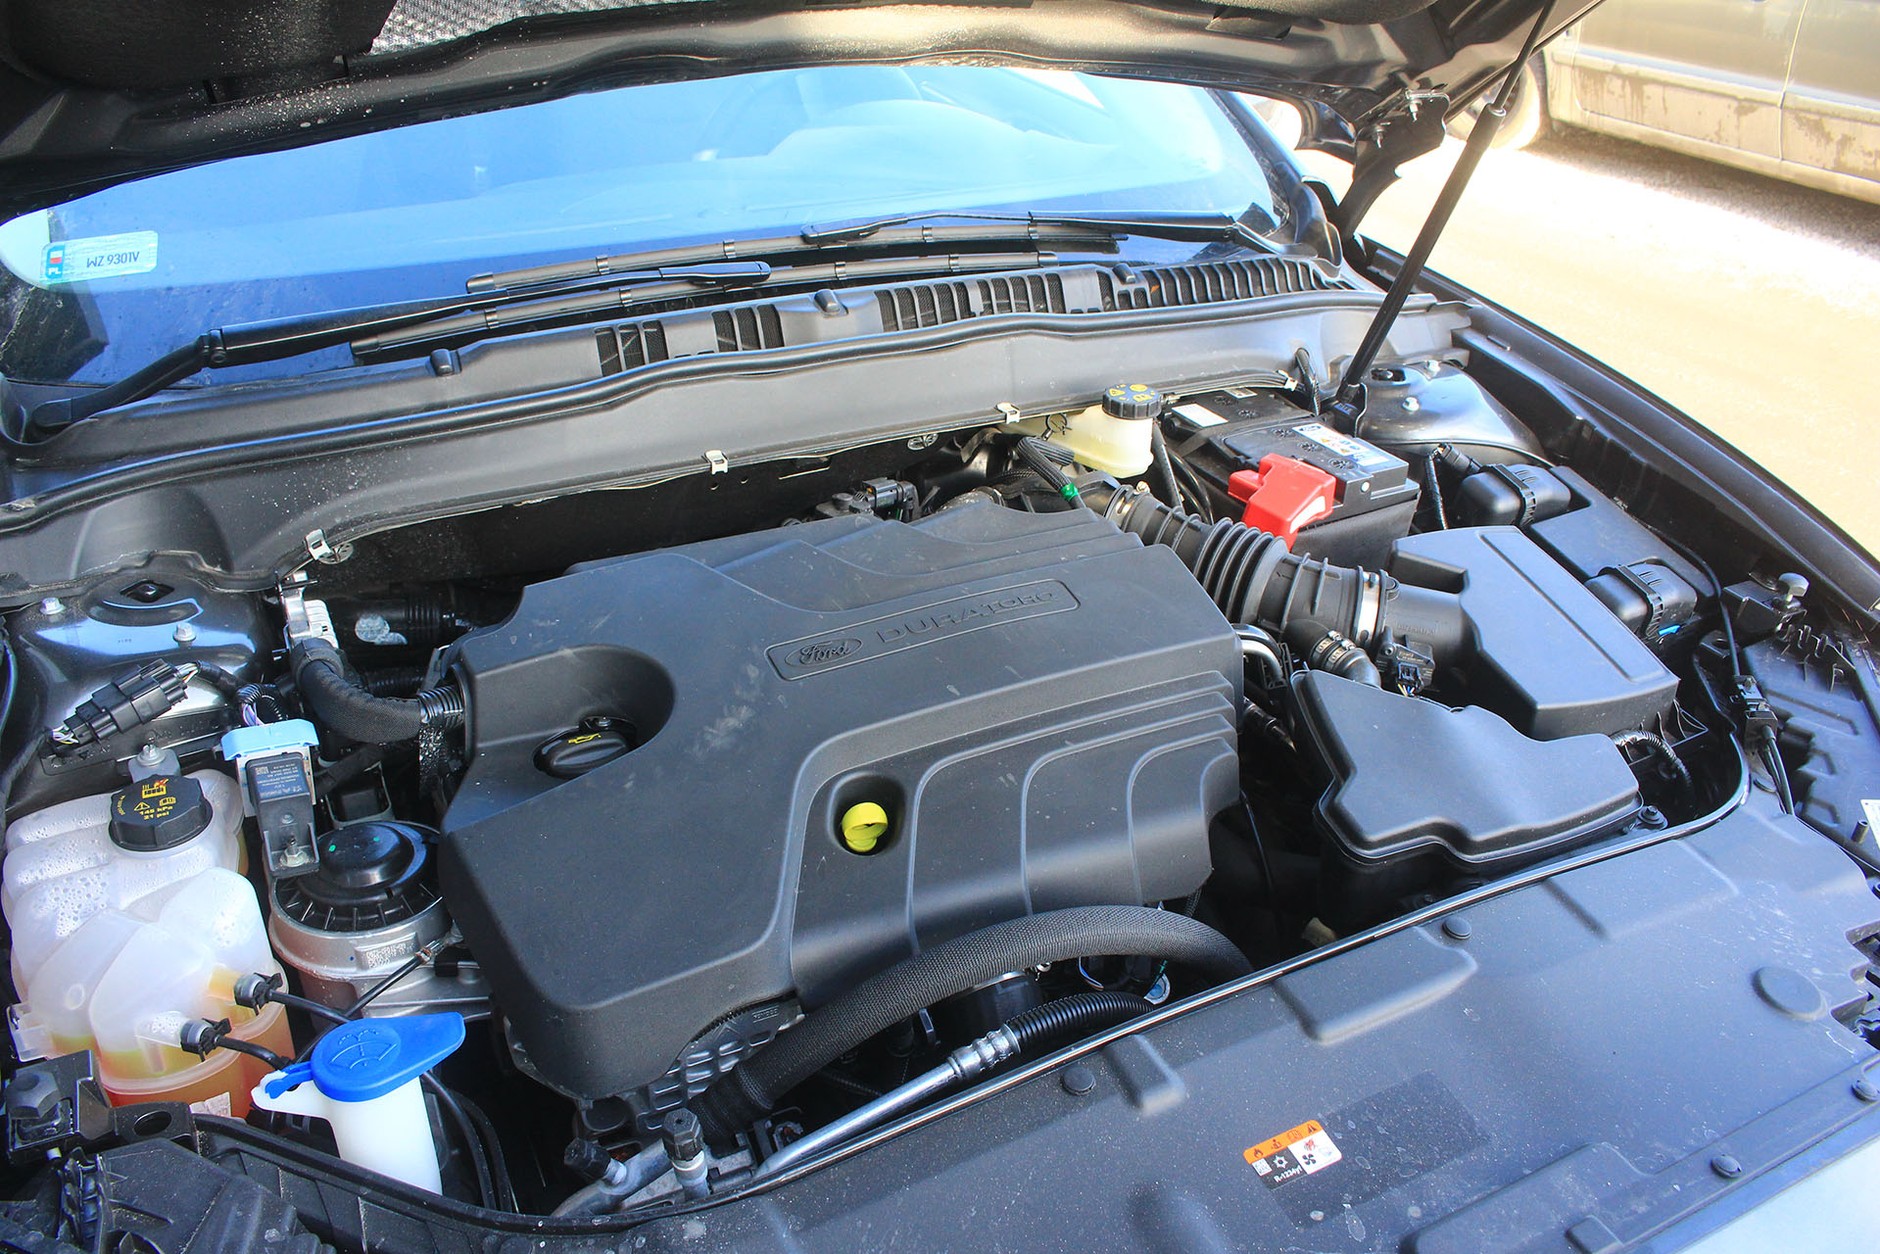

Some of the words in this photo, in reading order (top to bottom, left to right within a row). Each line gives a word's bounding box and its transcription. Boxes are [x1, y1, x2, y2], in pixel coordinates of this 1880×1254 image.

[86, 255, 104, 268] WZ
[48, 267, 61, 276] PL
[798, 640, 851, 665] Ford
[875, 592, 1059, 644] DURATORQ
